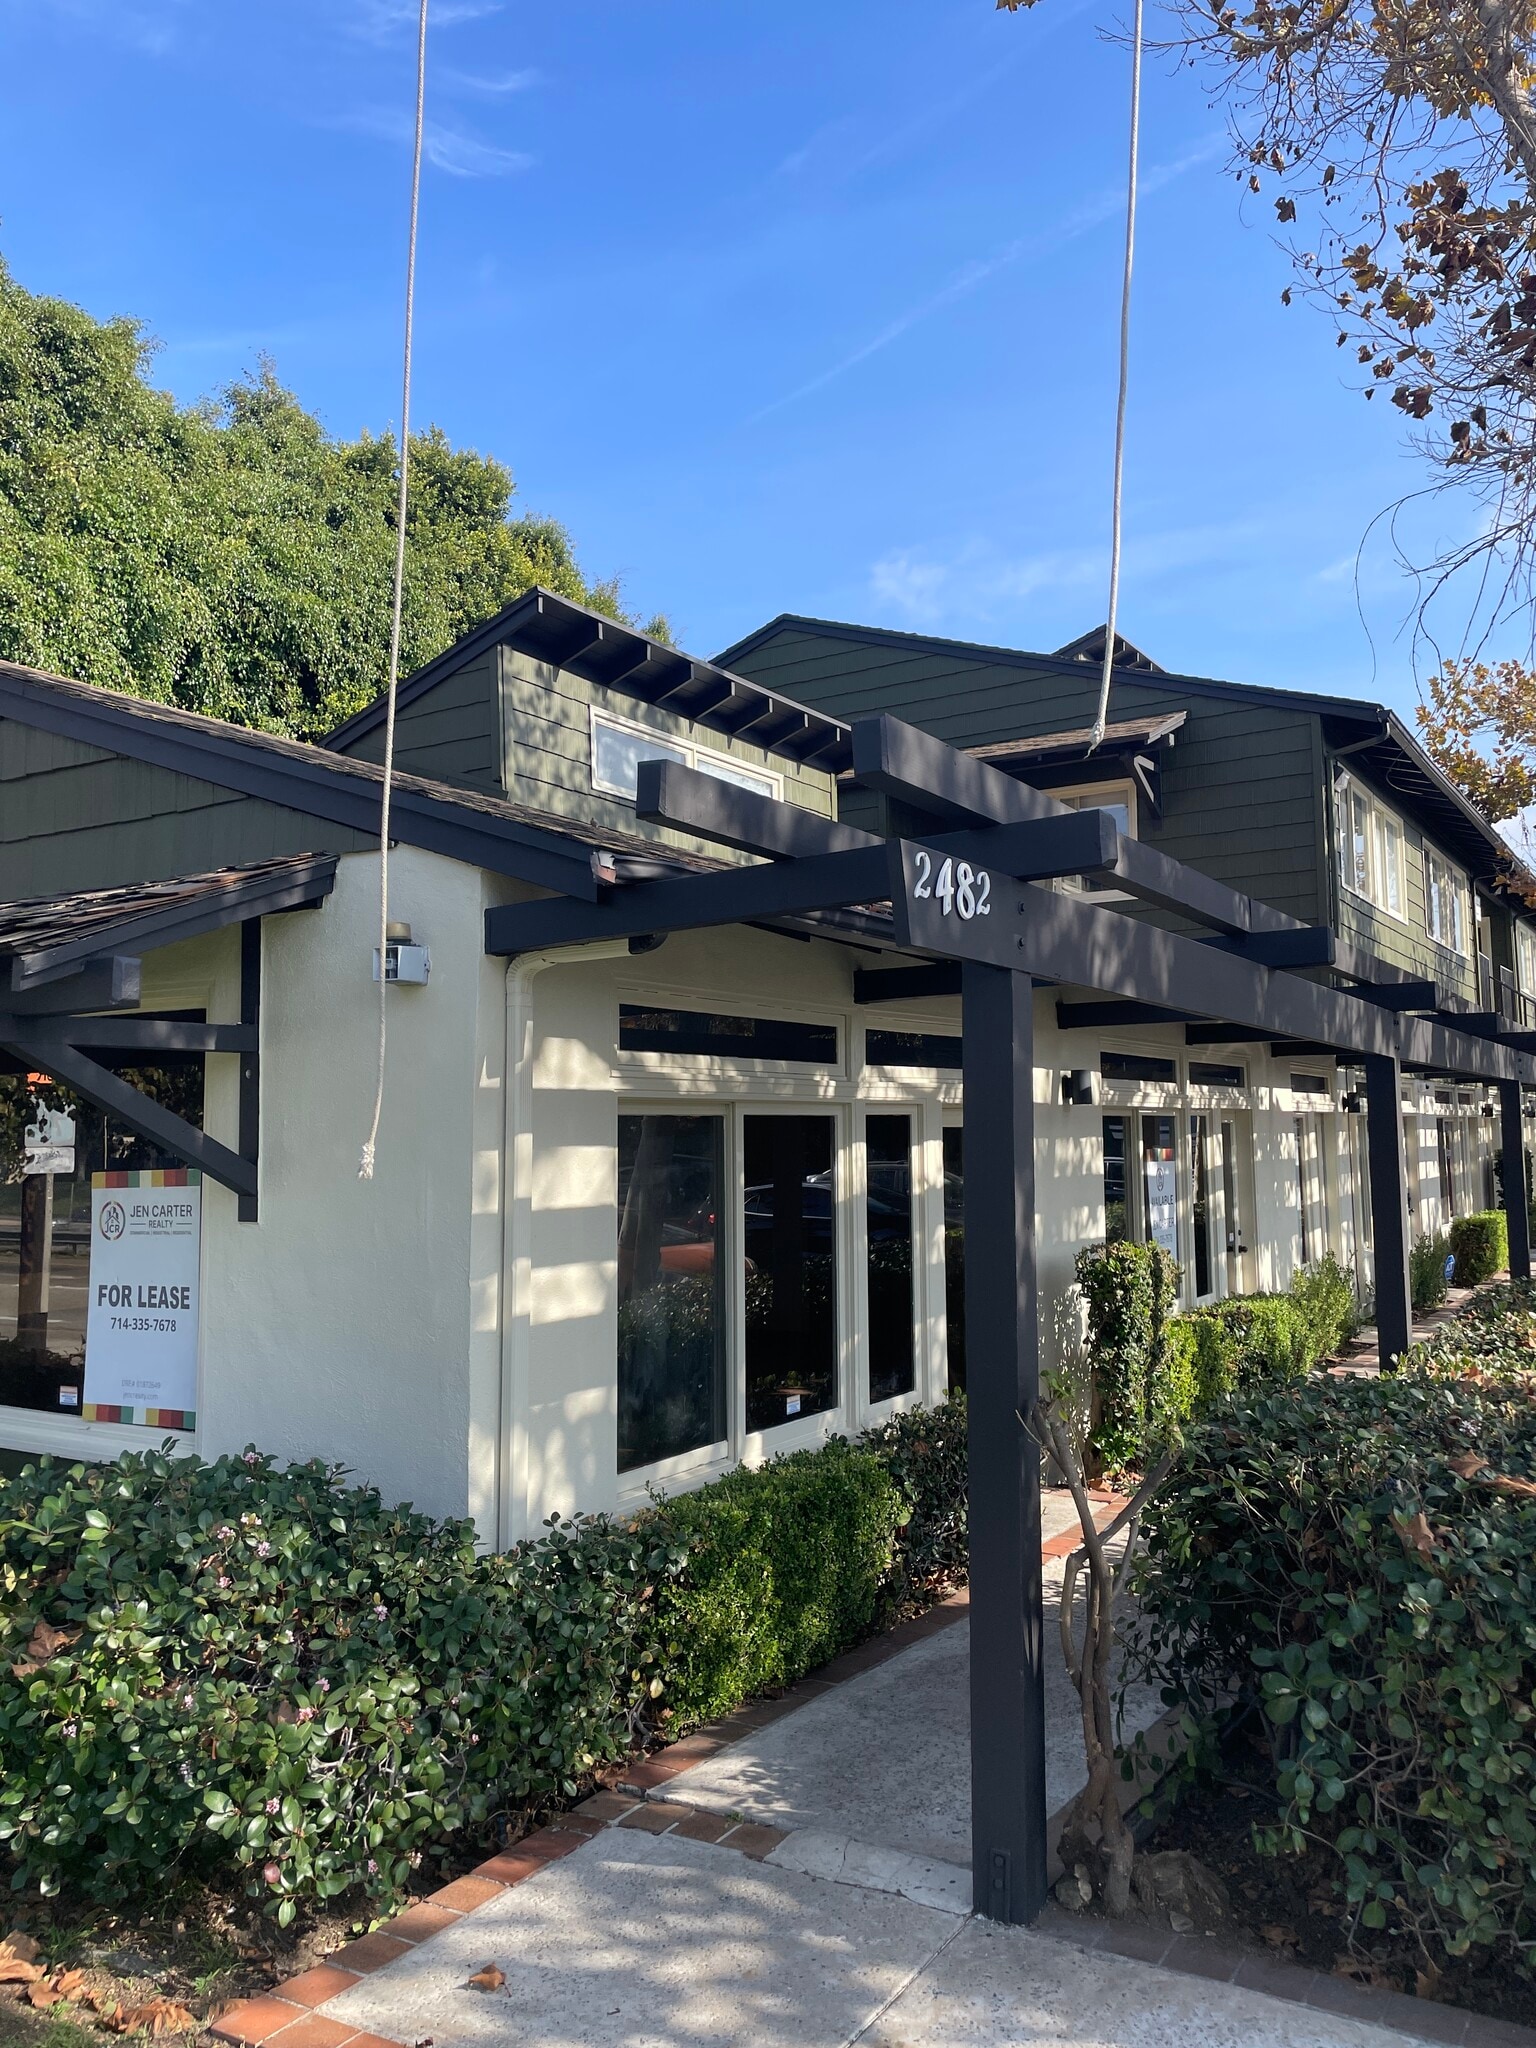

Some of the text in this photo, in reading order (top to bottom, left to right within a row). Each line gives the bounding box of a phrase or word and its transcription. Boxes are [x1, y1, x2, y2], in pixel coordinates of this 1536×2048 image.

[913, 851, 991, 921] 2482
[130, 1204, 193, 1218] JEN CARTER
[105, 1223, 120, 1234] JCR
[148, 1219, 173, 1229] REALTY
[98, 1284, 190, 1310] FOR LEASE
[110, 1317, 177, 1332] 714-335-7678
